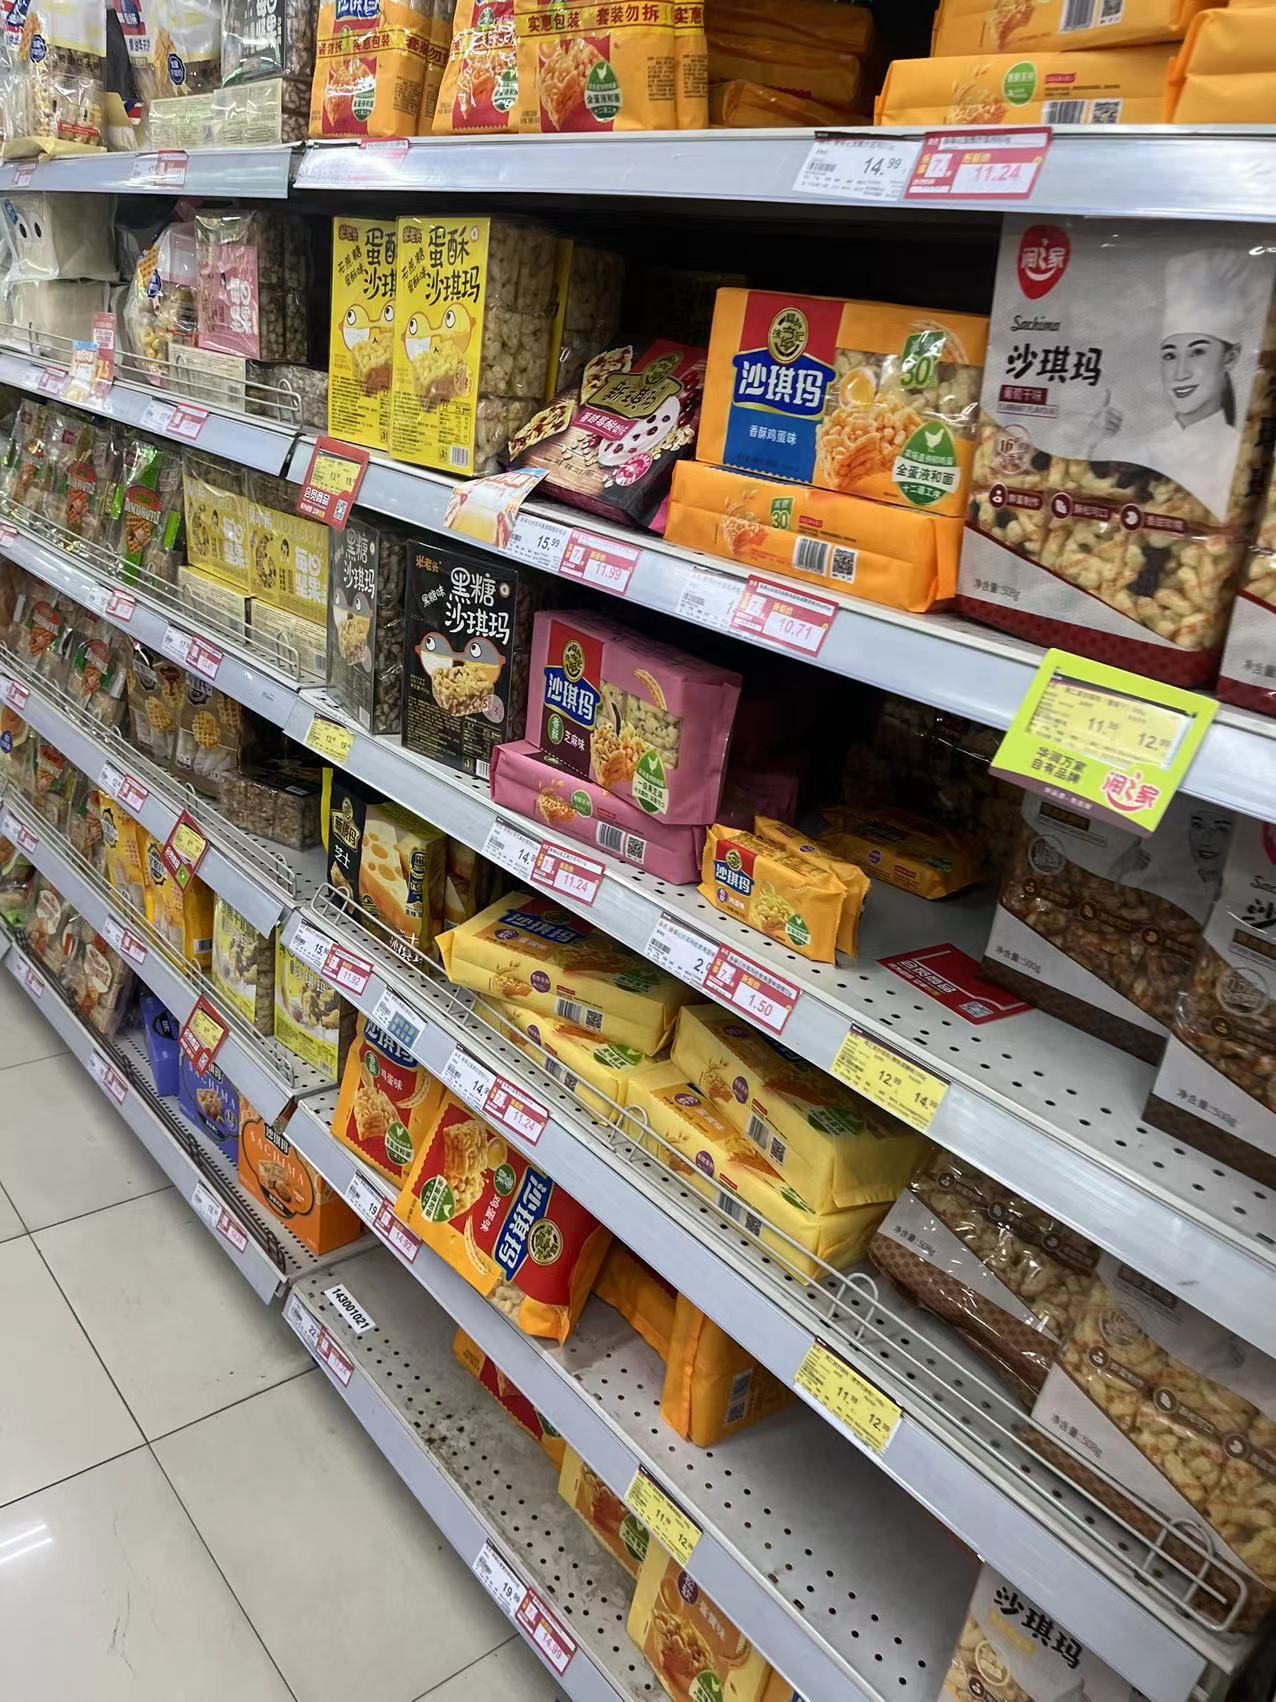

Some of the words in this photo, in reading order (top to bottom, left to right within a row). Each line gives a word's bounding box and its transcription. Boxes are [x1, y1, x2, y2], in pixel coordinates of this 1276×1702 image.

[528, 11, 580, 32] 实惠包装
[596, 4, 659, 25] 套装勿拆
[973, 164, 1021, 182] 11.24
[428, 226, 470, 268] 蛋酥
[425, 266, 480, 306] 沙琪玛
[1010, 314, 1061, 332] Sachima
[1006, 343, 1103, 387] 沙琪玛
[738, 361, 823, 407] 沙琪玛
[749, 424, 797, 446] 香酥鸡蛋味
[896, 463, 956, 486] 全蛋液和面
[772, 511, 789, 529] 30
[343, 560, 375, 599] 沙琪玛
[450, 566, 496, 607] 黑糖
[444, 603, 510, 645] 沙琪玛
[547, 673, 595, 720] 沙琪玛
[564, 730, 586, 751] 芝麻味
[1031, 759, 1081, 784] 自有品牌
[1036, 747, 1087, 773] 华润万家
[715, 863, 751, 893] 沙琪玛
[748, 993, 774, 1018] 1.50
[380, 1068, 403, 1091] 鸡蛋味
[513, 1112, 536, 1132] 11.24
[498, 1175, 547, 1269] 沙琪玛
[331, 1287, 370, 1330] 143001021
[992, 1586, 1083, 1669] 沙琪玛
